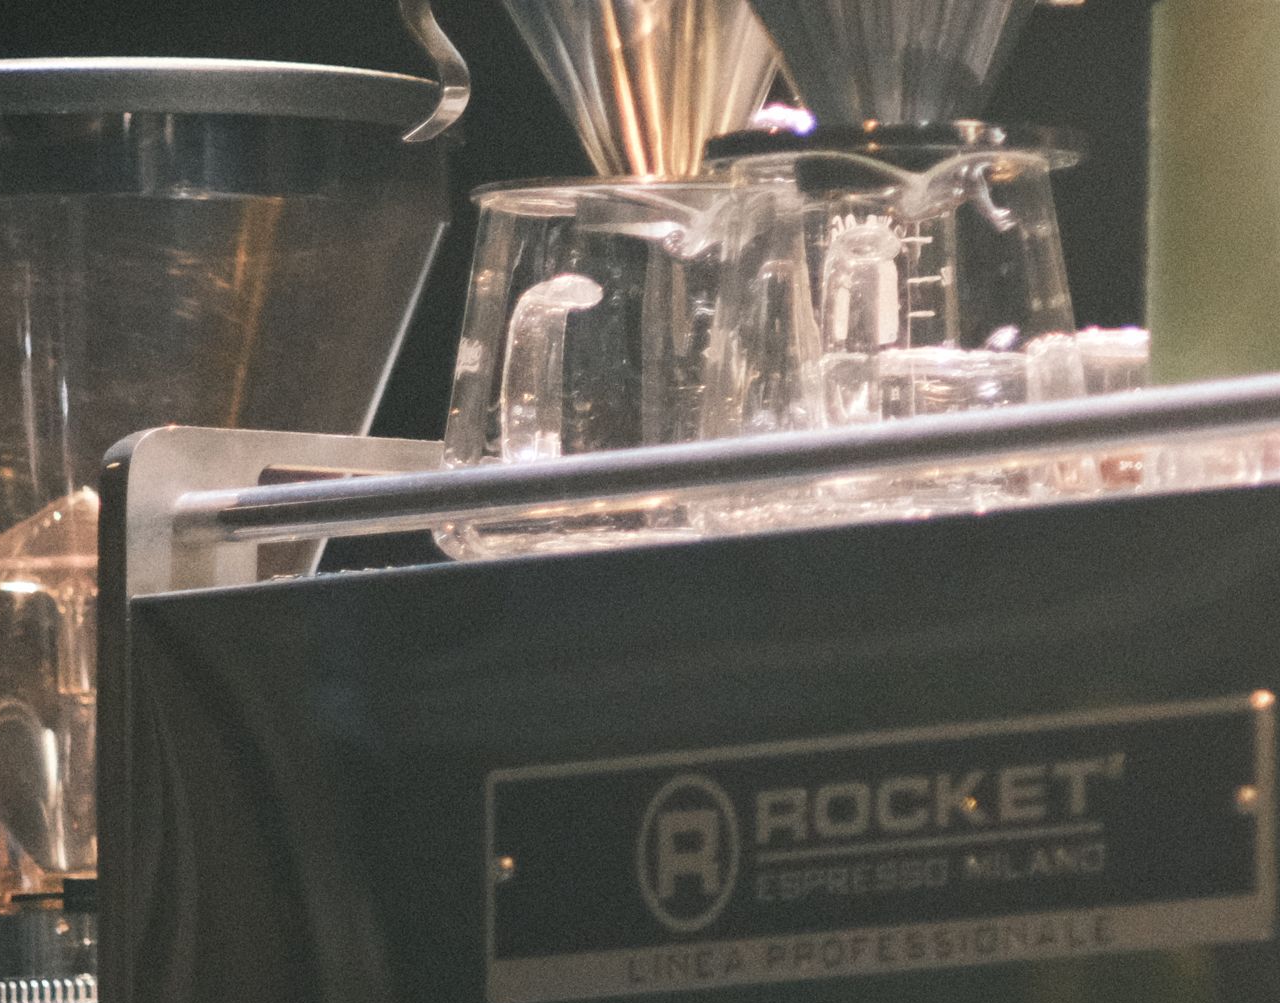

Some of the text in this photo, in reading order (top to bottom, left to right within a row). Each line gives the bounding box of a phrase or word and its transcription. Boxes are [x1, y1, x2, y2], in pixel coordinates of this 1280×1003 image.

[755, 758, 1105, 845] ROCKET
[756, 842, 1106, 901] ESPRESSO MILANO
[626, 913, 1114, 985] LINEA PROFESSIONALE
